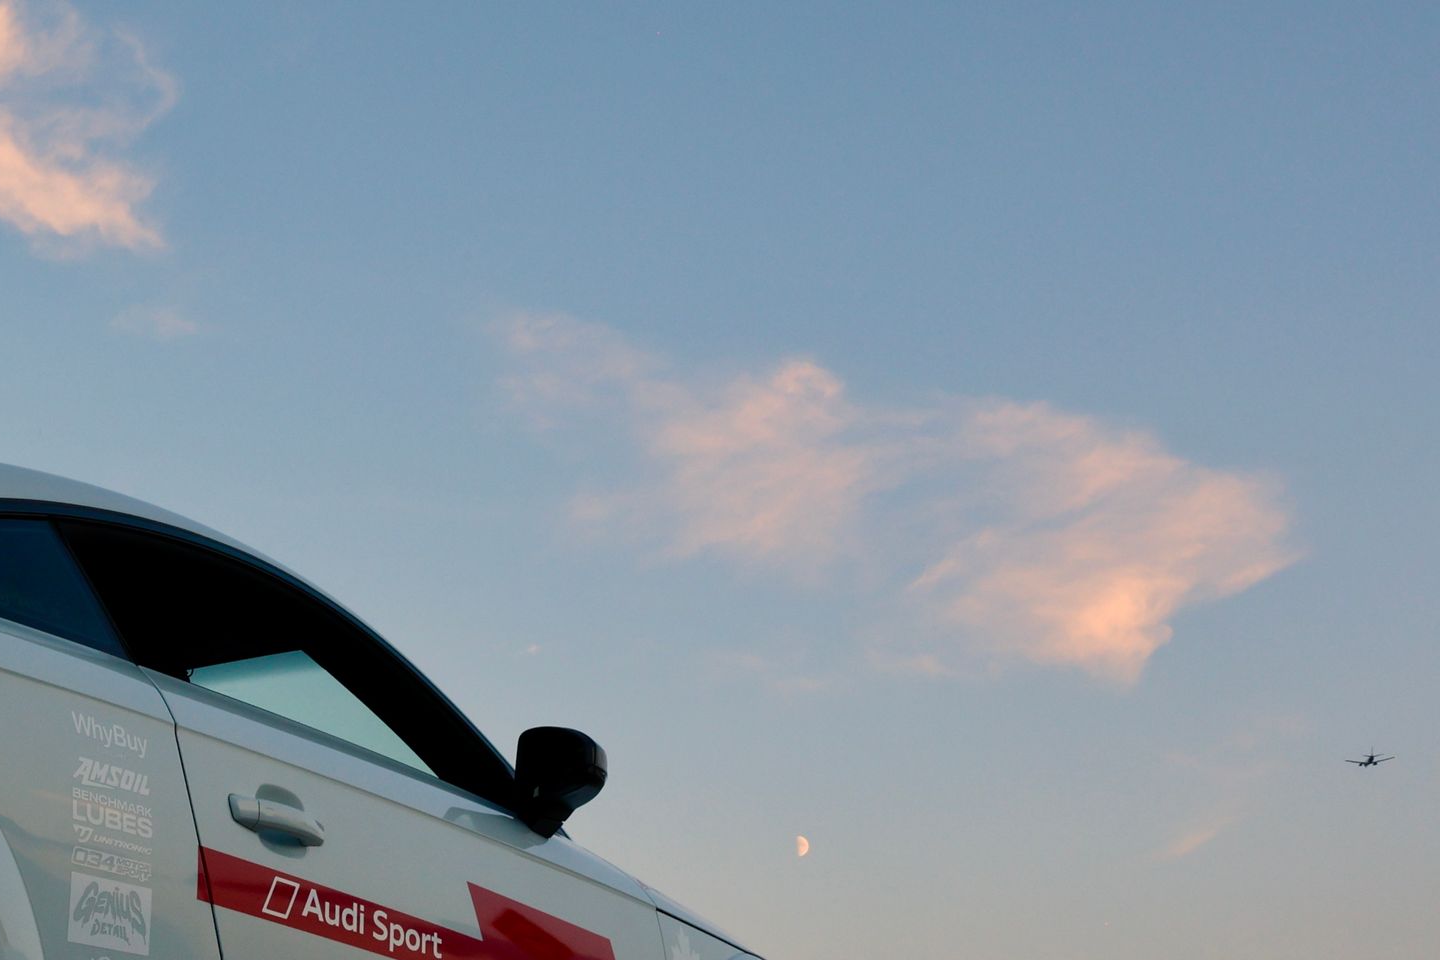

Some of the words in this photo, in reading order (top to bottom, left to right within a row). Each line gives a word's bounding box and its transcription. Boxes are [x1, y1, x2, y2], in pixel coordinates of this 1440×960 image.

[71, 710, 148, 759] WhyBuy
[72, 756, 151, 796] AMSOIL
[72, 786, 153, 818] BENCHMARK
[72, 800, 153, 839] LUBES
[301, 889, 365, 935] Audi
[372, 910, 442, 959] Sport
